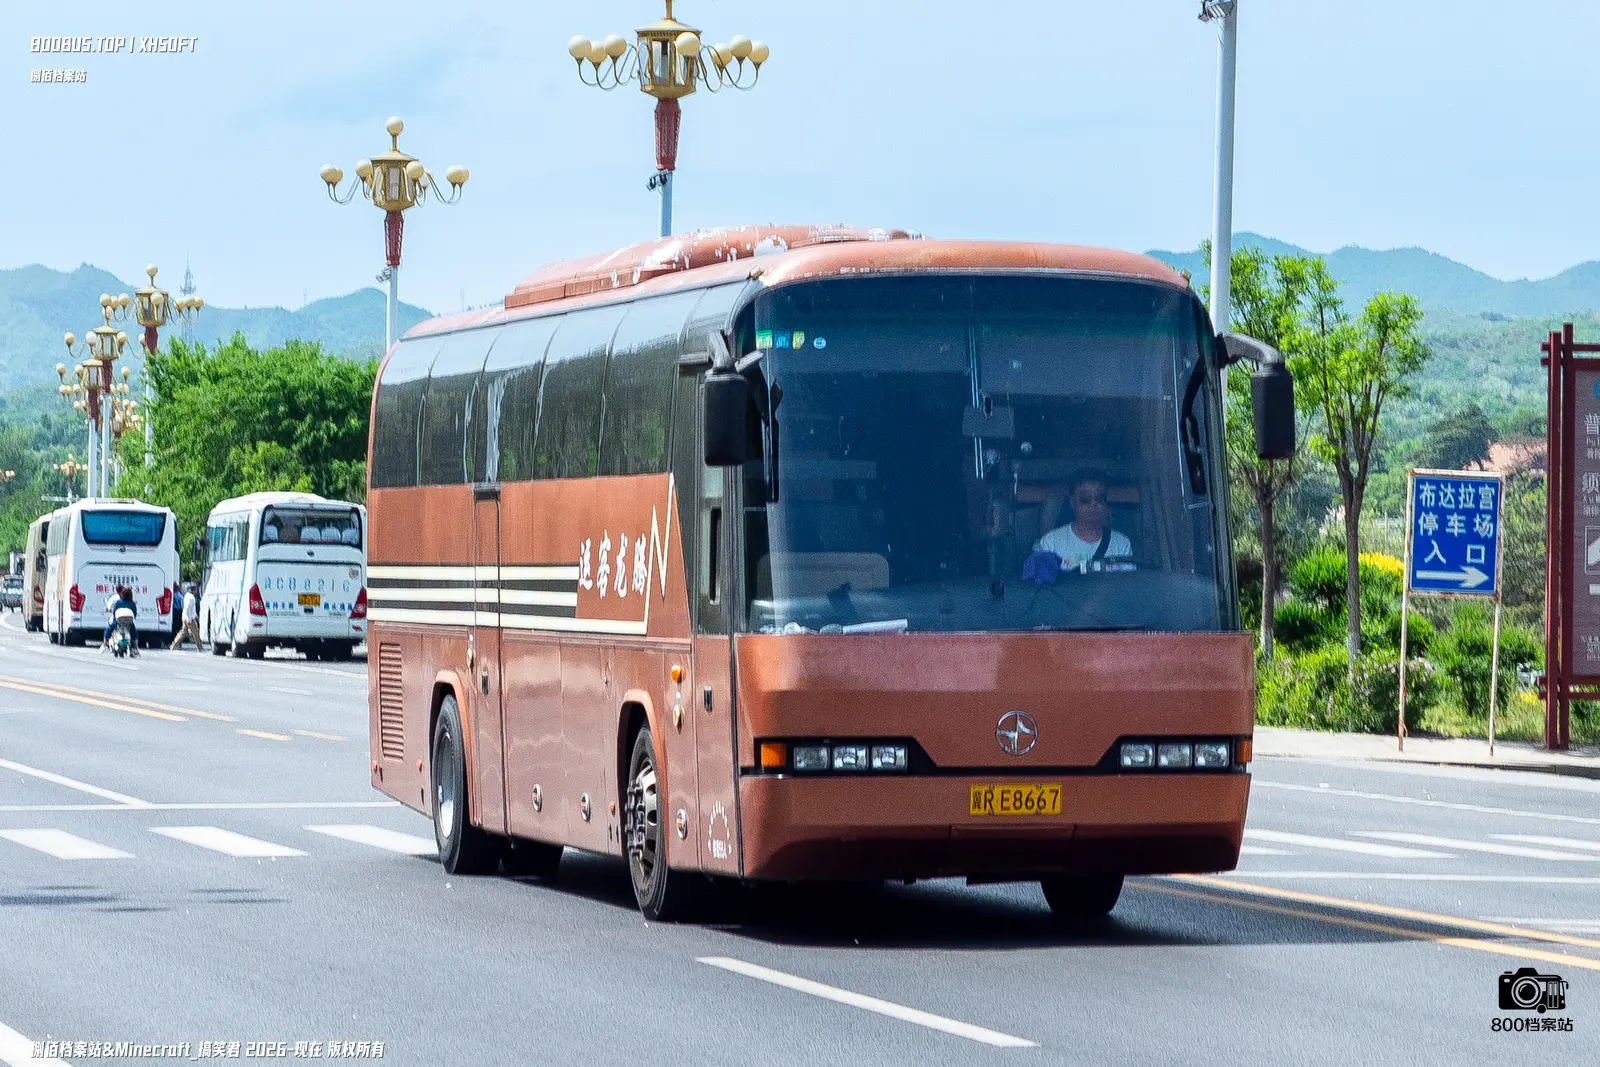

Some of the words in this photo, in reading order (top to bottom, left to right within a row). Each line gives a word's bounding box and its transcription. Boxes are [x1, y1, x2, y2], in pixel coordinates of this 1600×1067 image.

[1420, 481, 1495, 511] 布达拉宫
[1418, 511, 1494, 539] 停车场
[1424, 539, 1486, 565] 入口
